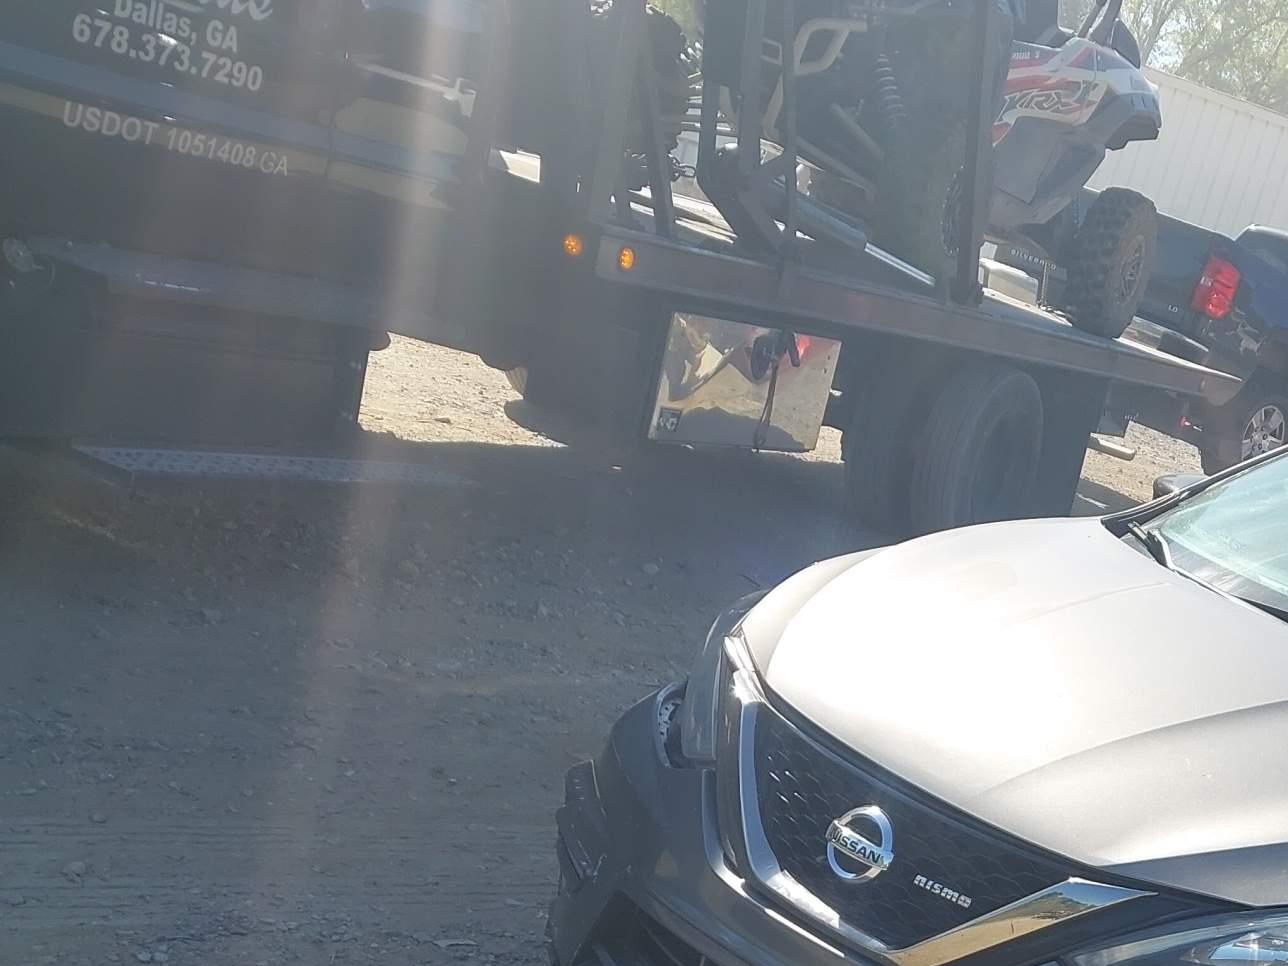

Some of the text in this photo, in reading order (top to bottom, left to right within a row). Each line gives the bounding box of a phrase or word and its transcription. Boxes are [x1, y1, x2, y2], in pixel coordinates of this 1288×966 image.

[72, 13, 263, 91] 678.373.7290
[113, 0, 197, 46] Dallas,
[206, 19, 238, 52] GA
[63, 101, 288, 176] USDOT 1051408 GA
[826, 824, 881, 863] NISSAN
